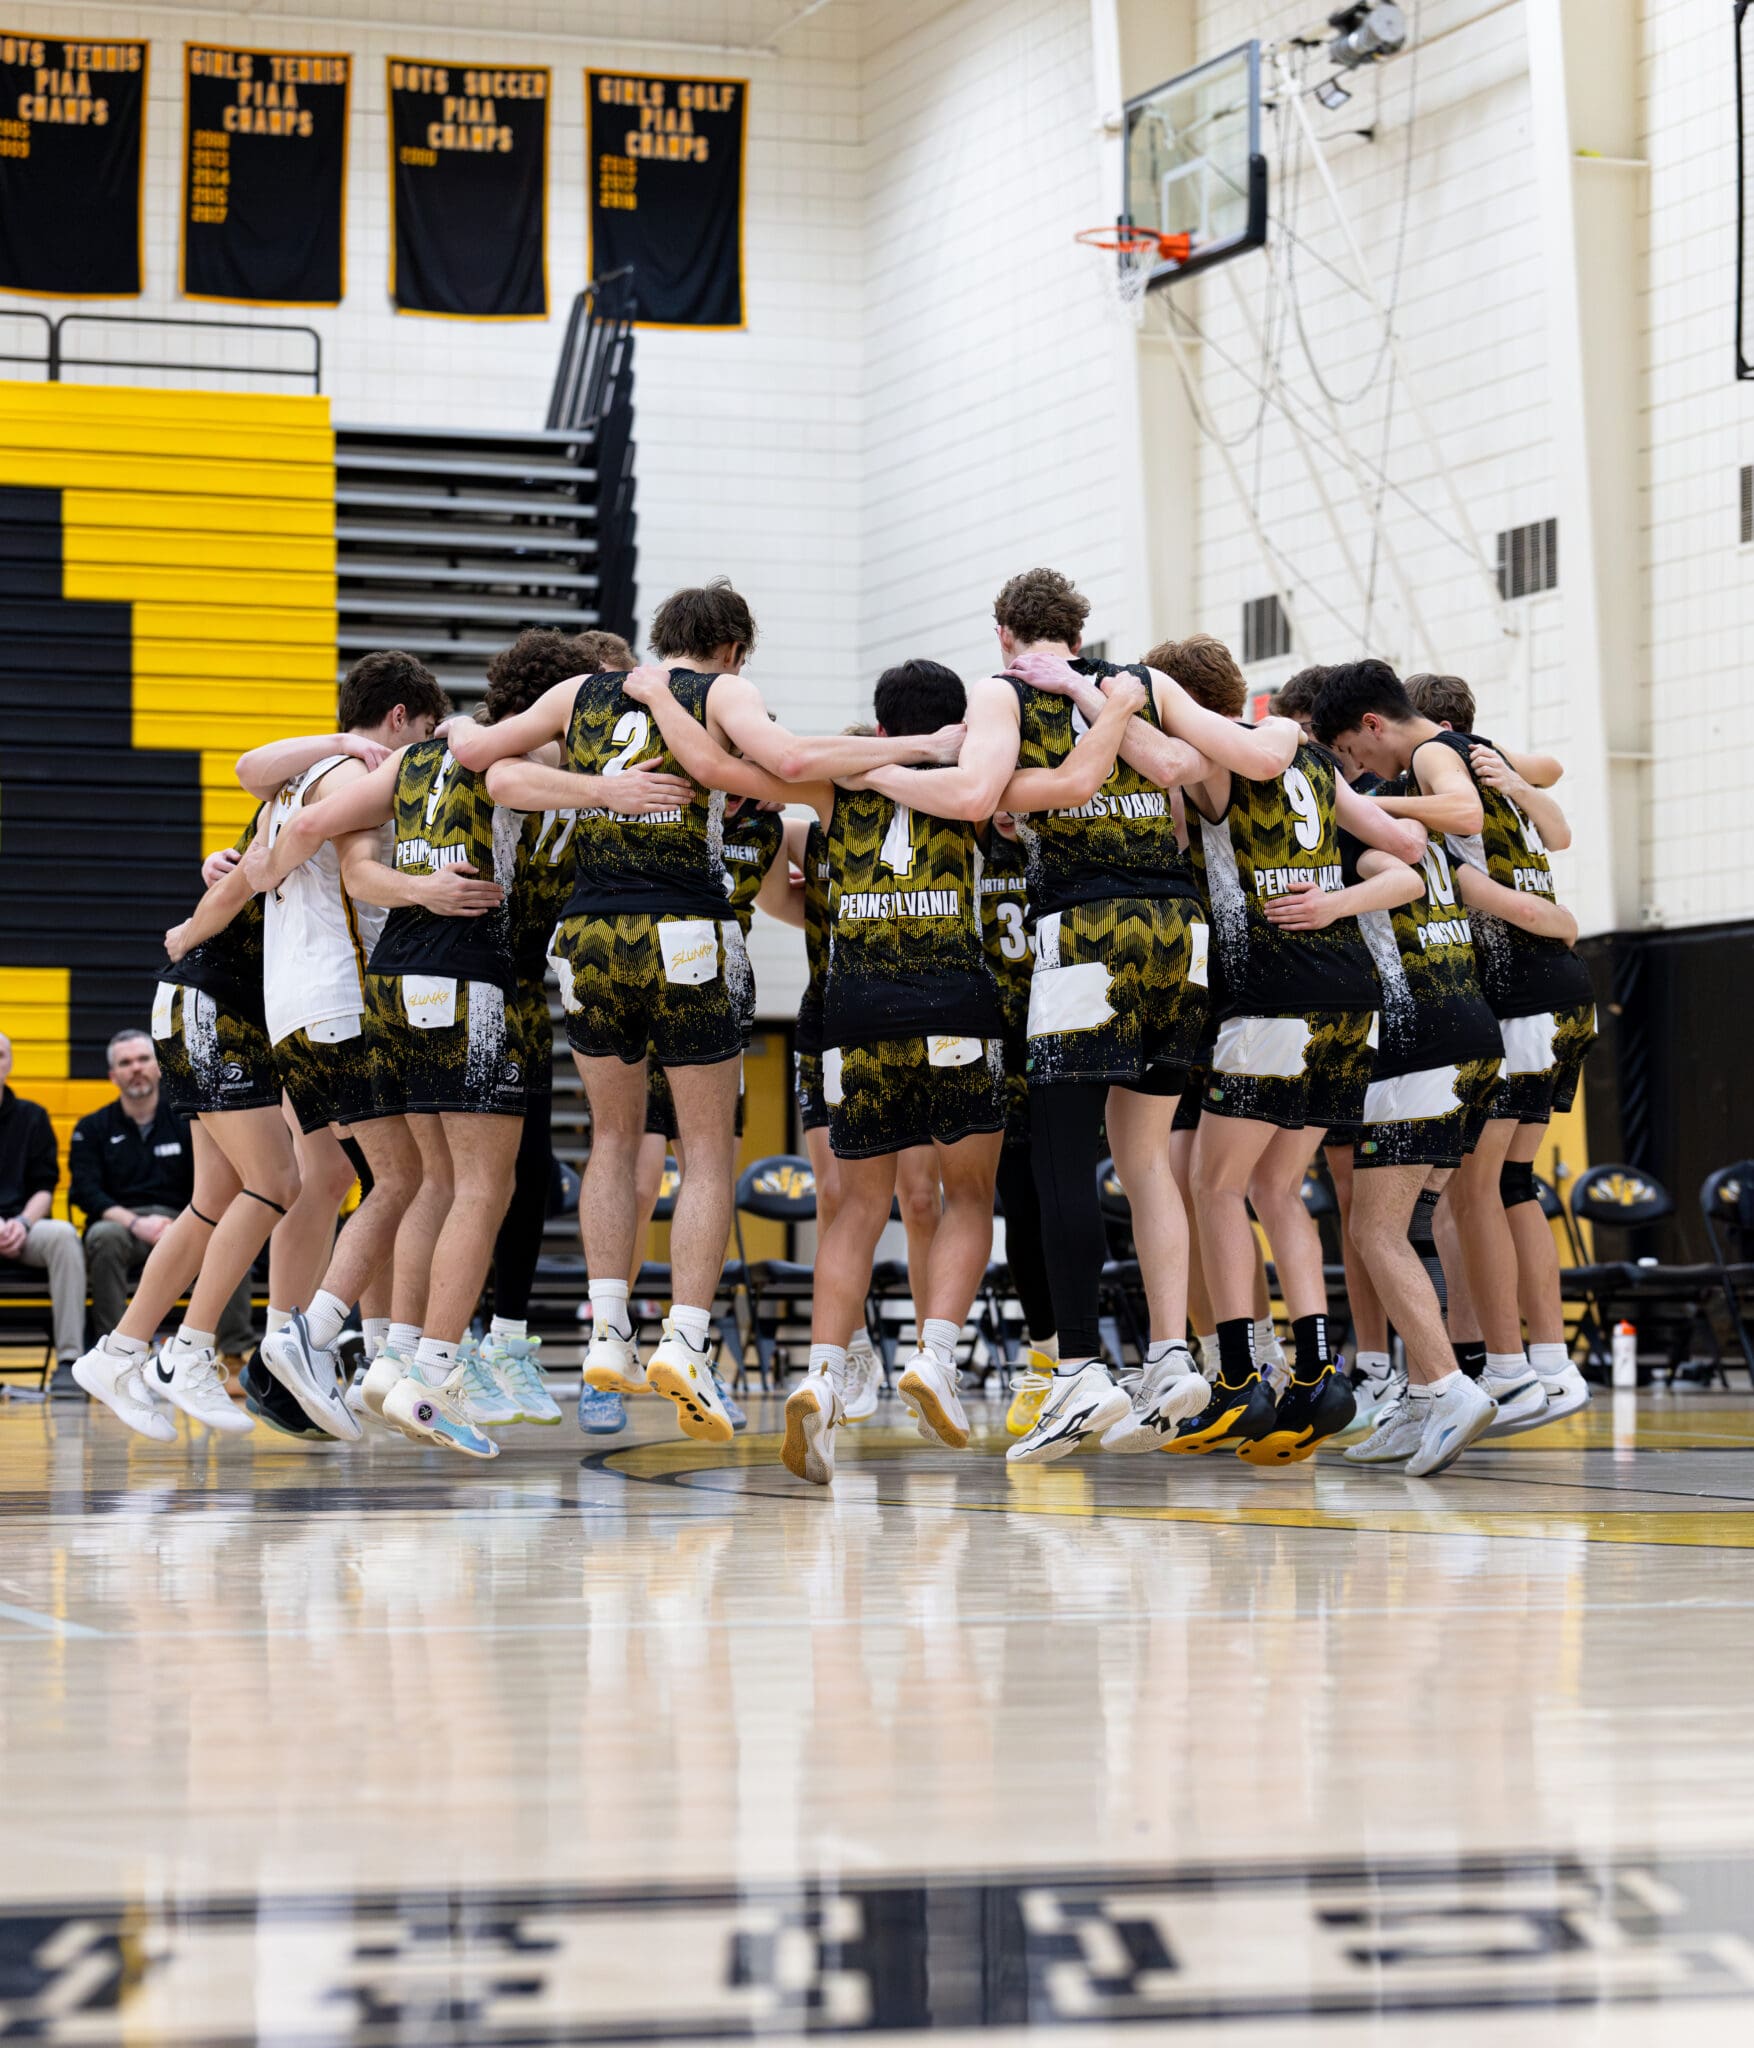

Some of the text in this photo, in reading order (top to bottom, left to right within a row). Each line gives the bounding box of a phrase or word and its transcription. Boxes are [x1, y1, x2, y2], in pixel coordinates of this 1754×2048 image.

[0, 38, 140, 71] OYS TENNIS
[190, 48, 347, 84] GIRLS TENNIS
[35, 67, 91, 96] PIAA
[238, 81, 299, 109] PIAA
[392, 63, 546, 99] BOYS SOCCER
[599, 77, 736, 113] GIRLS GOLF
[18, 93, 109, 126] CHAMPS
[222, 104, 314, 137] CHAMPS
[443, 96, 497, 123] PIAA
[639, 106, 694, 134] PIAA
[427, 121, 513, 153] CHAMPS
[625, 130, 709, 163] CHAMPS
[602, 710, 650, 777] 2
[1283, 766, 1325, 855] 9
[723, 844, 761, 863] GHENY
[880, 799, 917, 880] 4
